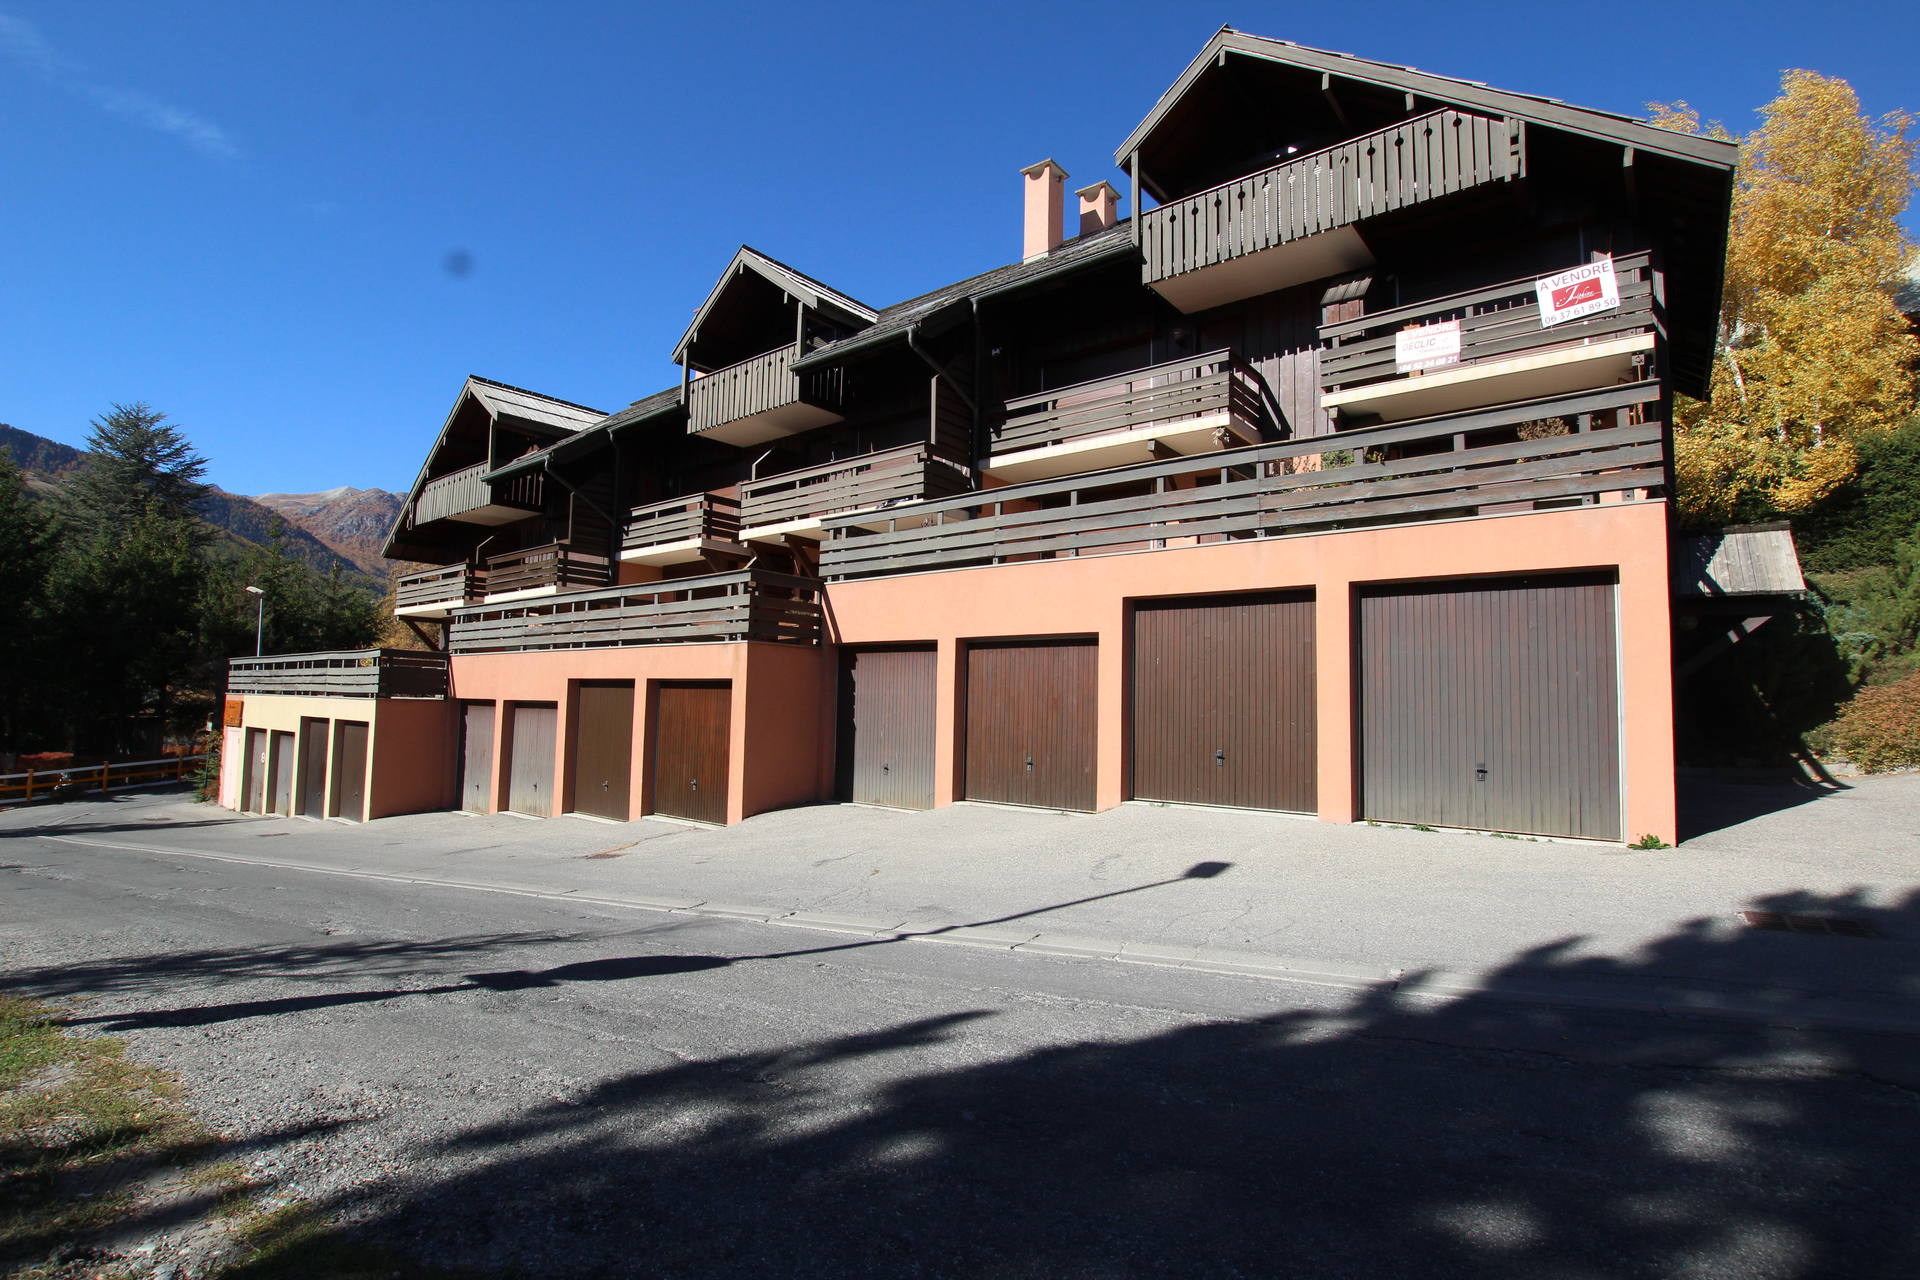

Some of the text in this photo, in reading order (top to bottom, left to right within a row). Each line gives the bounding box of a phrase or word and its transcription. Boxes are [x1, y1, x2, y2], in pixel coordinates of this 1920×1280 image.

[1540, 262, 1610, 291] A VENDRE
[1545, 297, 1617, 324] 06 37 61 89 50
